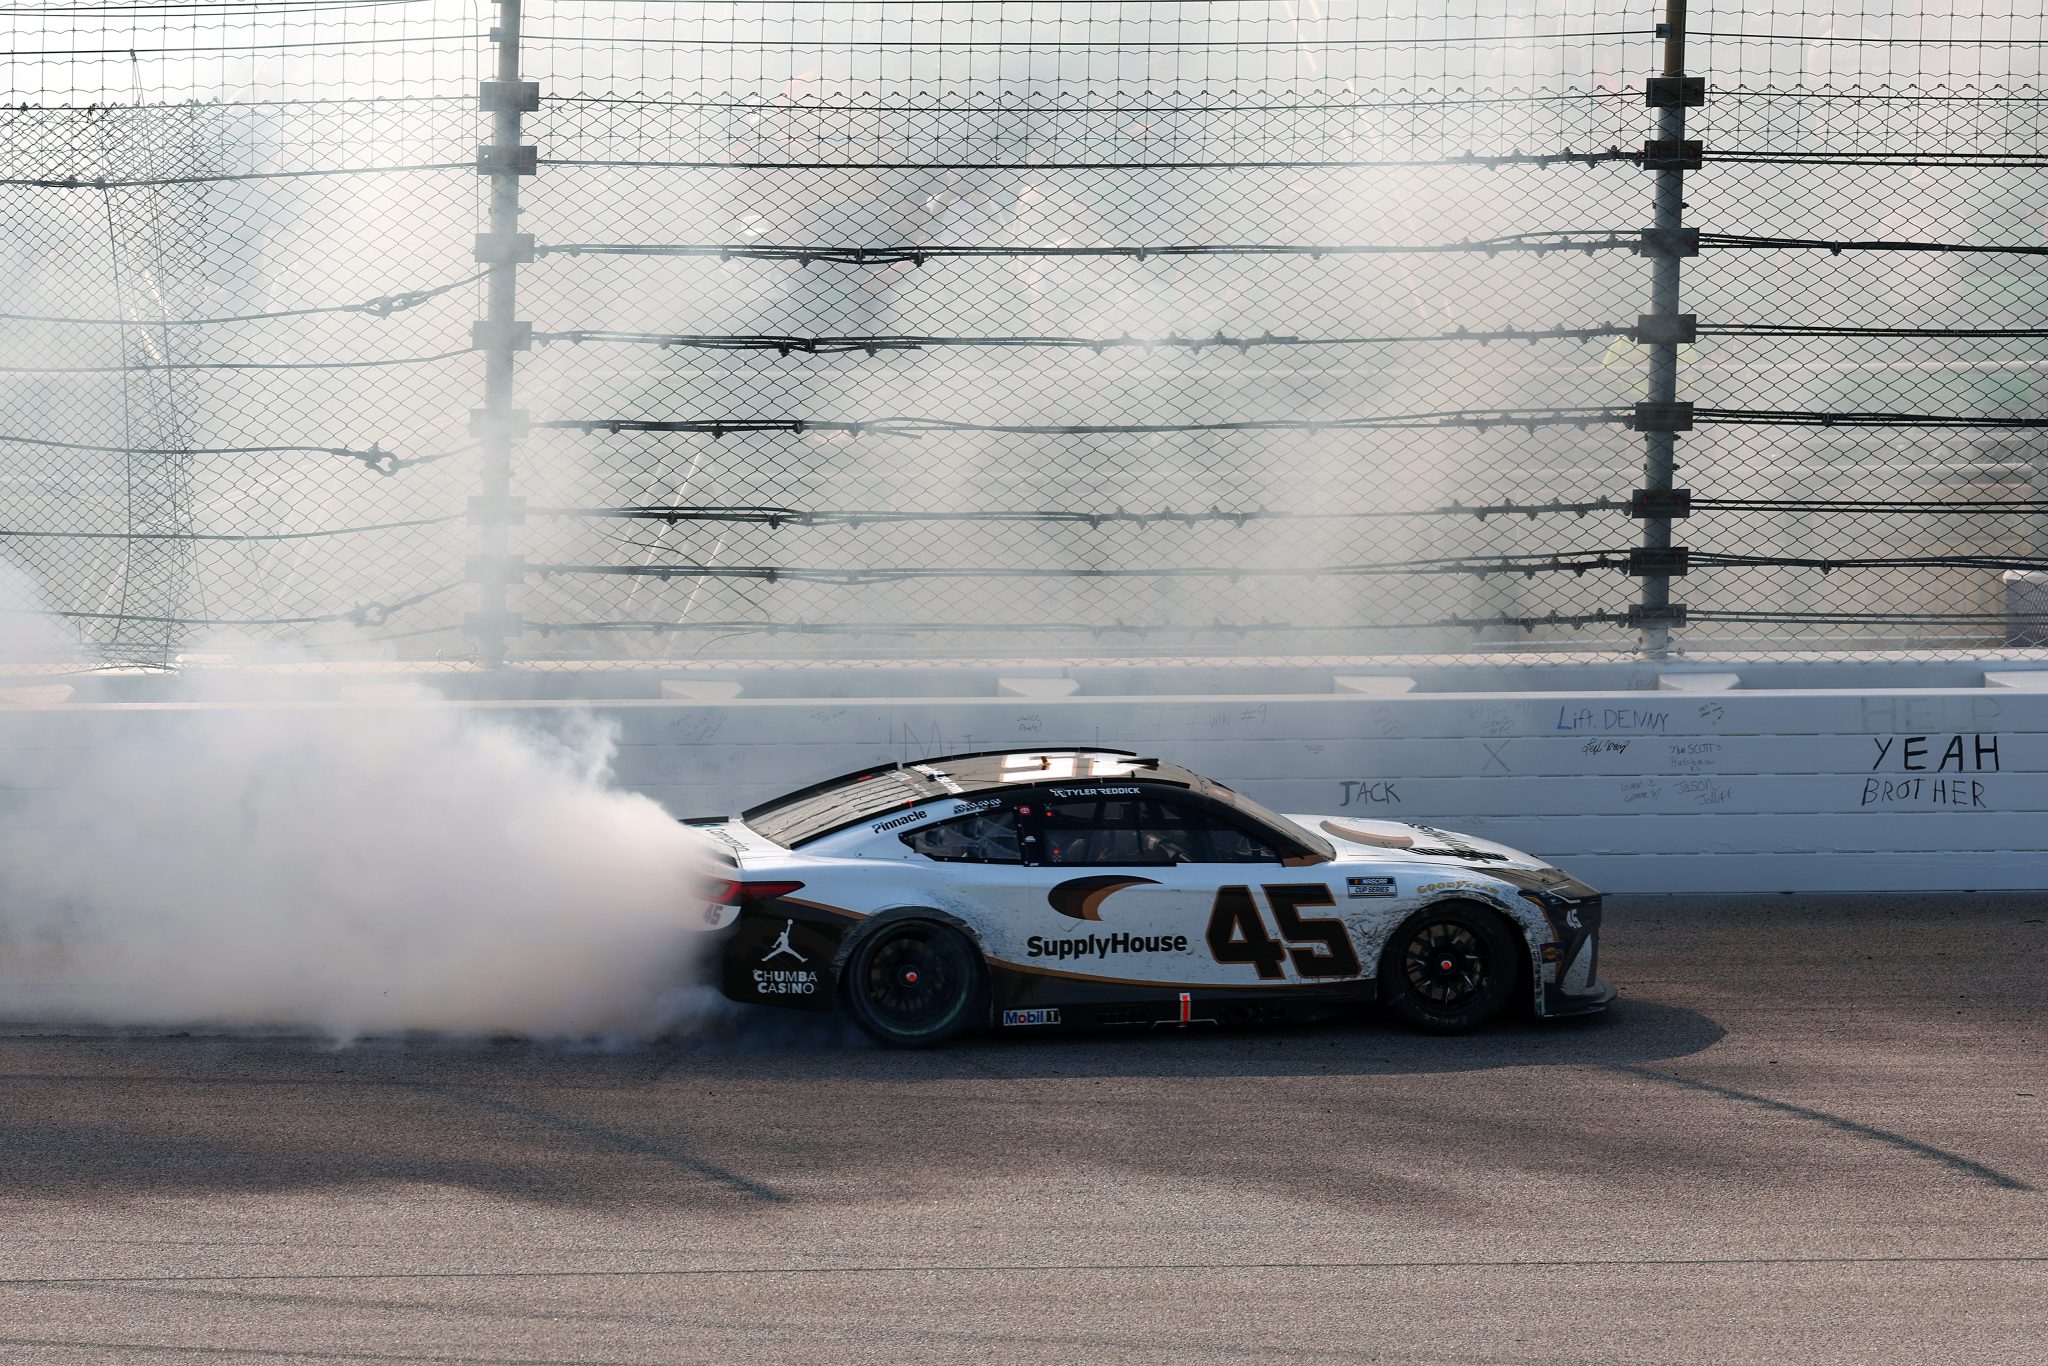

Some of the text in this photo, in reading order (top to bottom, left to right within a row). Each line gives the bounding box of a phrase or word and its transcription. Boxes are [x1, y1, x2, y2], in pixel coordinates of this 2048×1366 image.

[1604, 709, 1669, 732] DENNY
[1872, 733, 2001, 773] YEAH
[1065, 787, 1141, 796] TYLER REDDICK
[1339, 780, 1402, 807] JACK
[1861, 777, 1988, 809] BROTHER
[872, 809, 928, 834] Pinnacle
[1206, 884, 1362, 980] 45
[1027, 932, 1188, 961] SupplyHouse
[752, 968, 818, 982] CHUMBA
[757, 982, 815, 995] CASINO
[1004, 1010, 1044, 1025] Mobil
